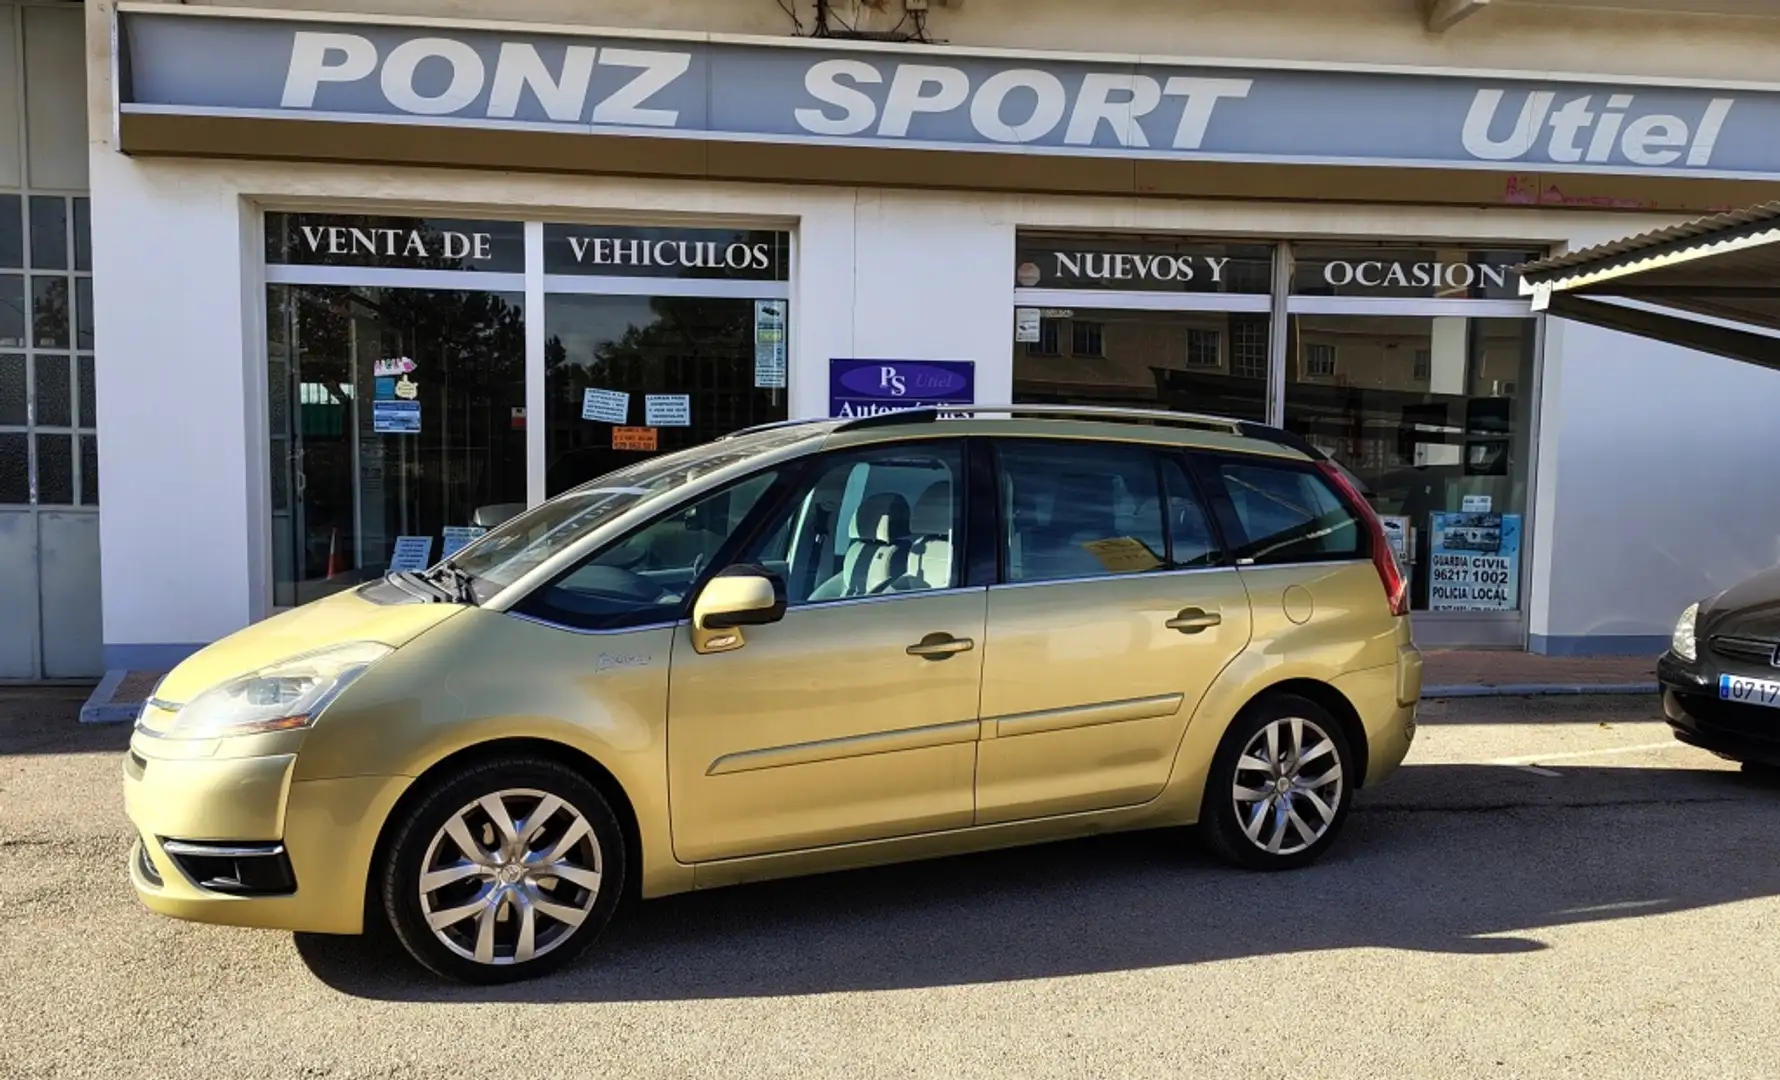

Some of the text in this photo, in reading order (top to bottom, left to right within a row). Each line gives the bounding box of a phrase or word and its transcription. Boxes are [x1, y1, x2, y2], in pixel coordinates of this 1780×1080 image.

[279, 31, 1735, 166] PONZ SPORT Utiel
[301, 226, 429, 257] VENTA
[441, 231, 492, 259] DE
[566, 236, 769, 269] VEHICULOS
[1054, 252, 1194, 282] NUEVOS
[1204, 257, 1231, 282] Y
[1323, 260, 1507, 288] OCASION
[1432, 554, 1508, 570] GUARDIA CIVIL
[1433, 568, 1508, 584] 96217 1002
[1432, 586, 1508, 601] POLICIA LOCAL
[1733, 680, 1780, 704] 0717
